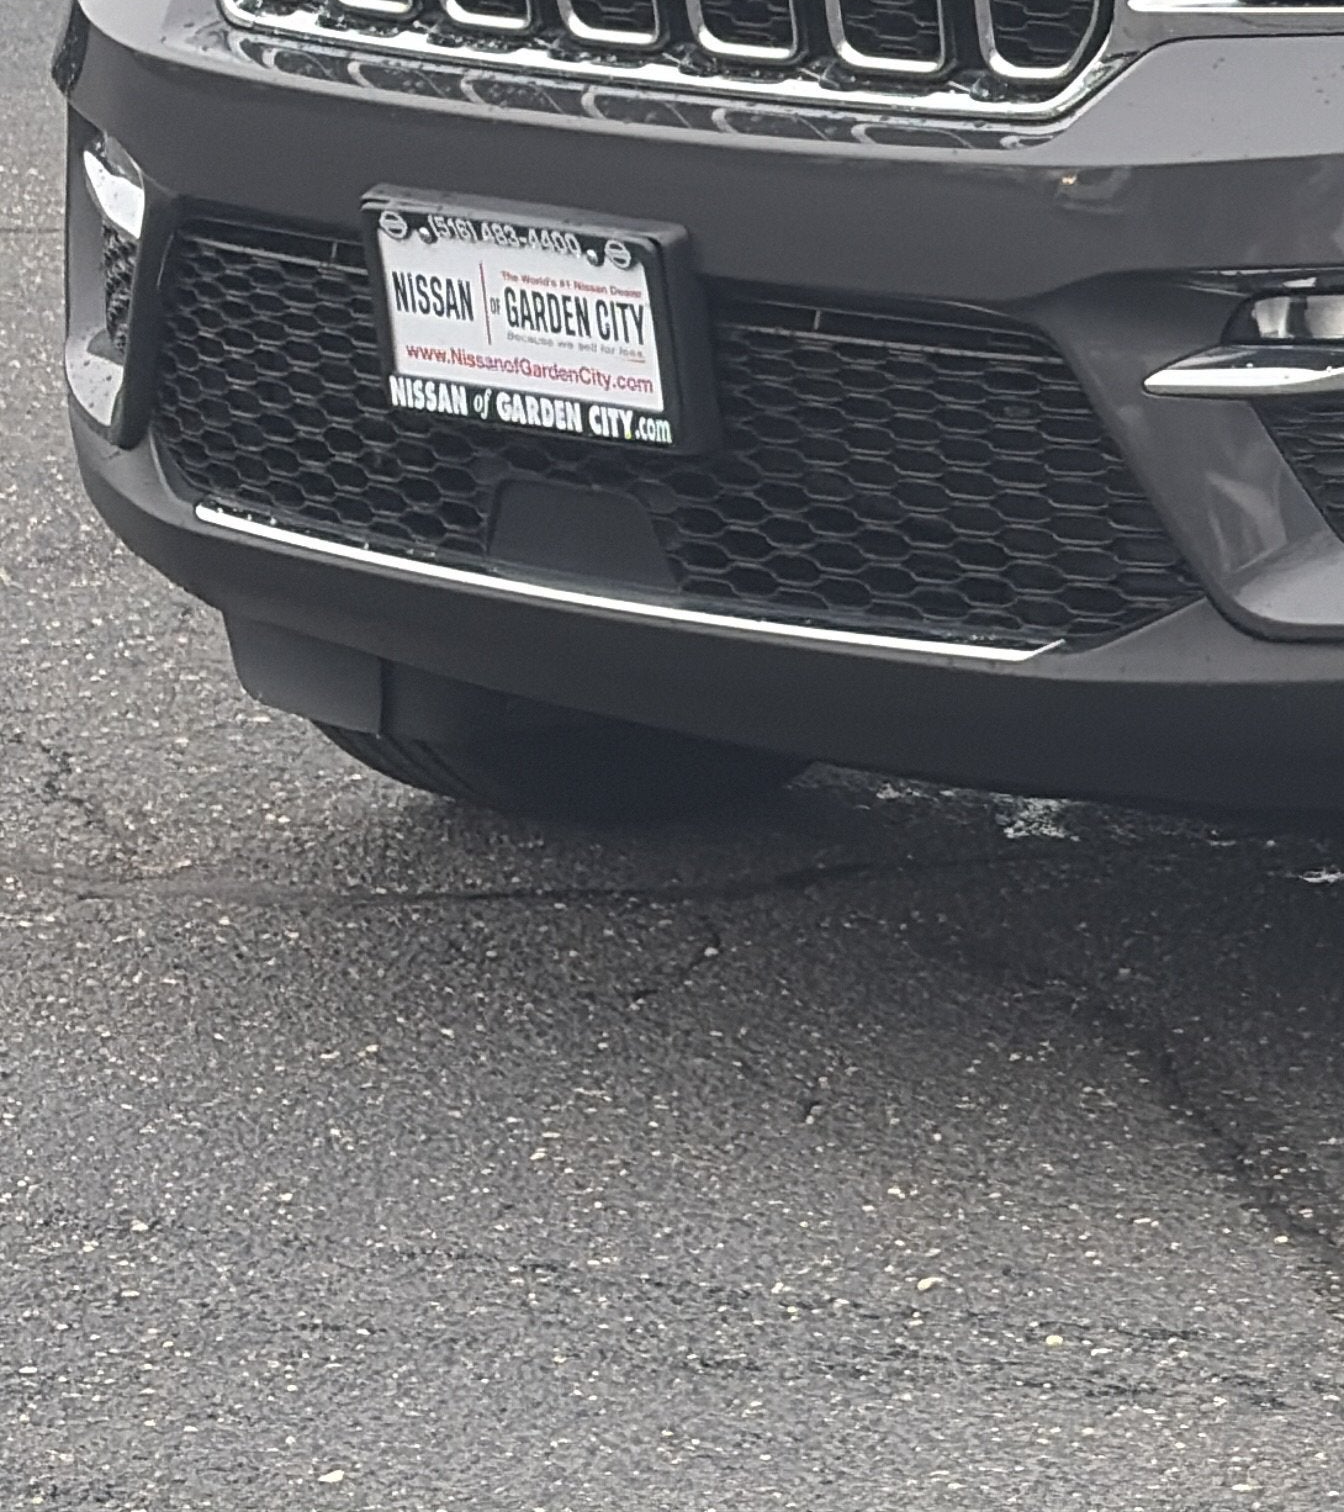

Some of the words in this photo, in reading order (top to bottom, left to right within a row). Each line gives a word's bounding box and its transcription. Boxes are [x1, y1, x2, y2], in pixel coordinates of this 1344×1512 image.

[427, 214, 478, 243] (516)
[392, 271, 475, 322] NISSAN
[490, 296, 501, 315] OF
[503, 286, 592, 339] GARDEN
[595, 299, 645, 346] CITY
[405, 344, 655, 394] www.NissanofGardenCity.com
[389, 375, 469, 417] NISSAN
[473, 388, 493, 420] of
[496, 391, 583, 434] GARDEN
[588, 404, 673, 444] CITY.com
